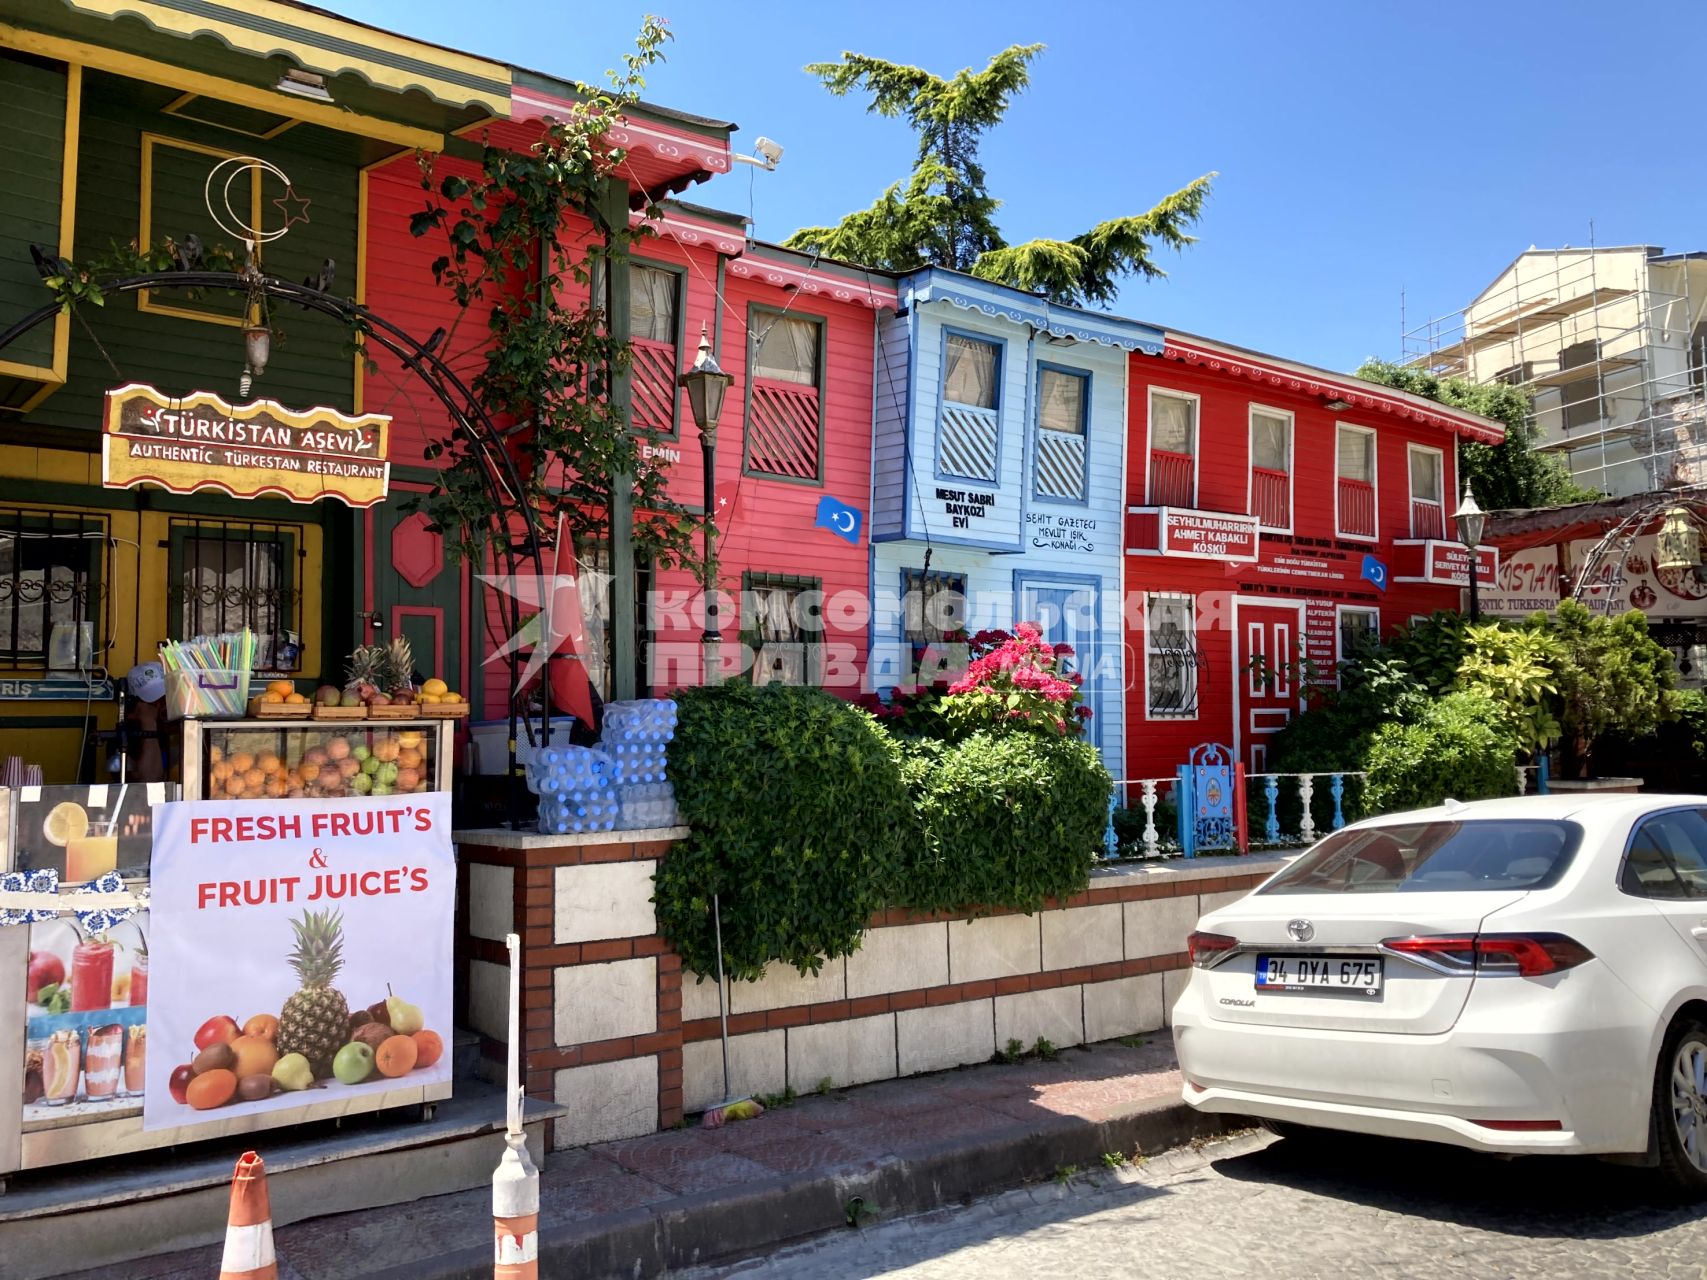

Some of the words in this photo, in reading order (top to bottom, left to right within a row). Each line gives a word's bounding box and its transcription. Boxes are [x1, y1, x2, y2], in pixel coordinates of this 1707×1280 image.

[161, 411, 291, 446] TÜRKİSTAN
[307, 460, 384, 479] RESTAURANT
[936, 487, 966, 502] MESUT
[968, 493, 995, 507] SABRİ
[953, 517, 969, 529] EVİ
[1173, 529, 1206, 541] AHMET
[1208, 531, 1248, 545] KABAKLI
[1446, 551, 1482, 563] SÜLEYN
[191, 814, 302, 844] FRESH
[311, 805, 432, 838] FRUIT'S
[309, 847, 329, 869] &
[198, 877, 301, 910] FRUIT
[307, 866, 430, 901] JUICE'S
[1268, 960, 1288, 983] 34
[1298, 961, 1330, 984] DYA
[1340, 962, 1375, 986] 675
[1219, 997, 1256, 1008] COROLLA
